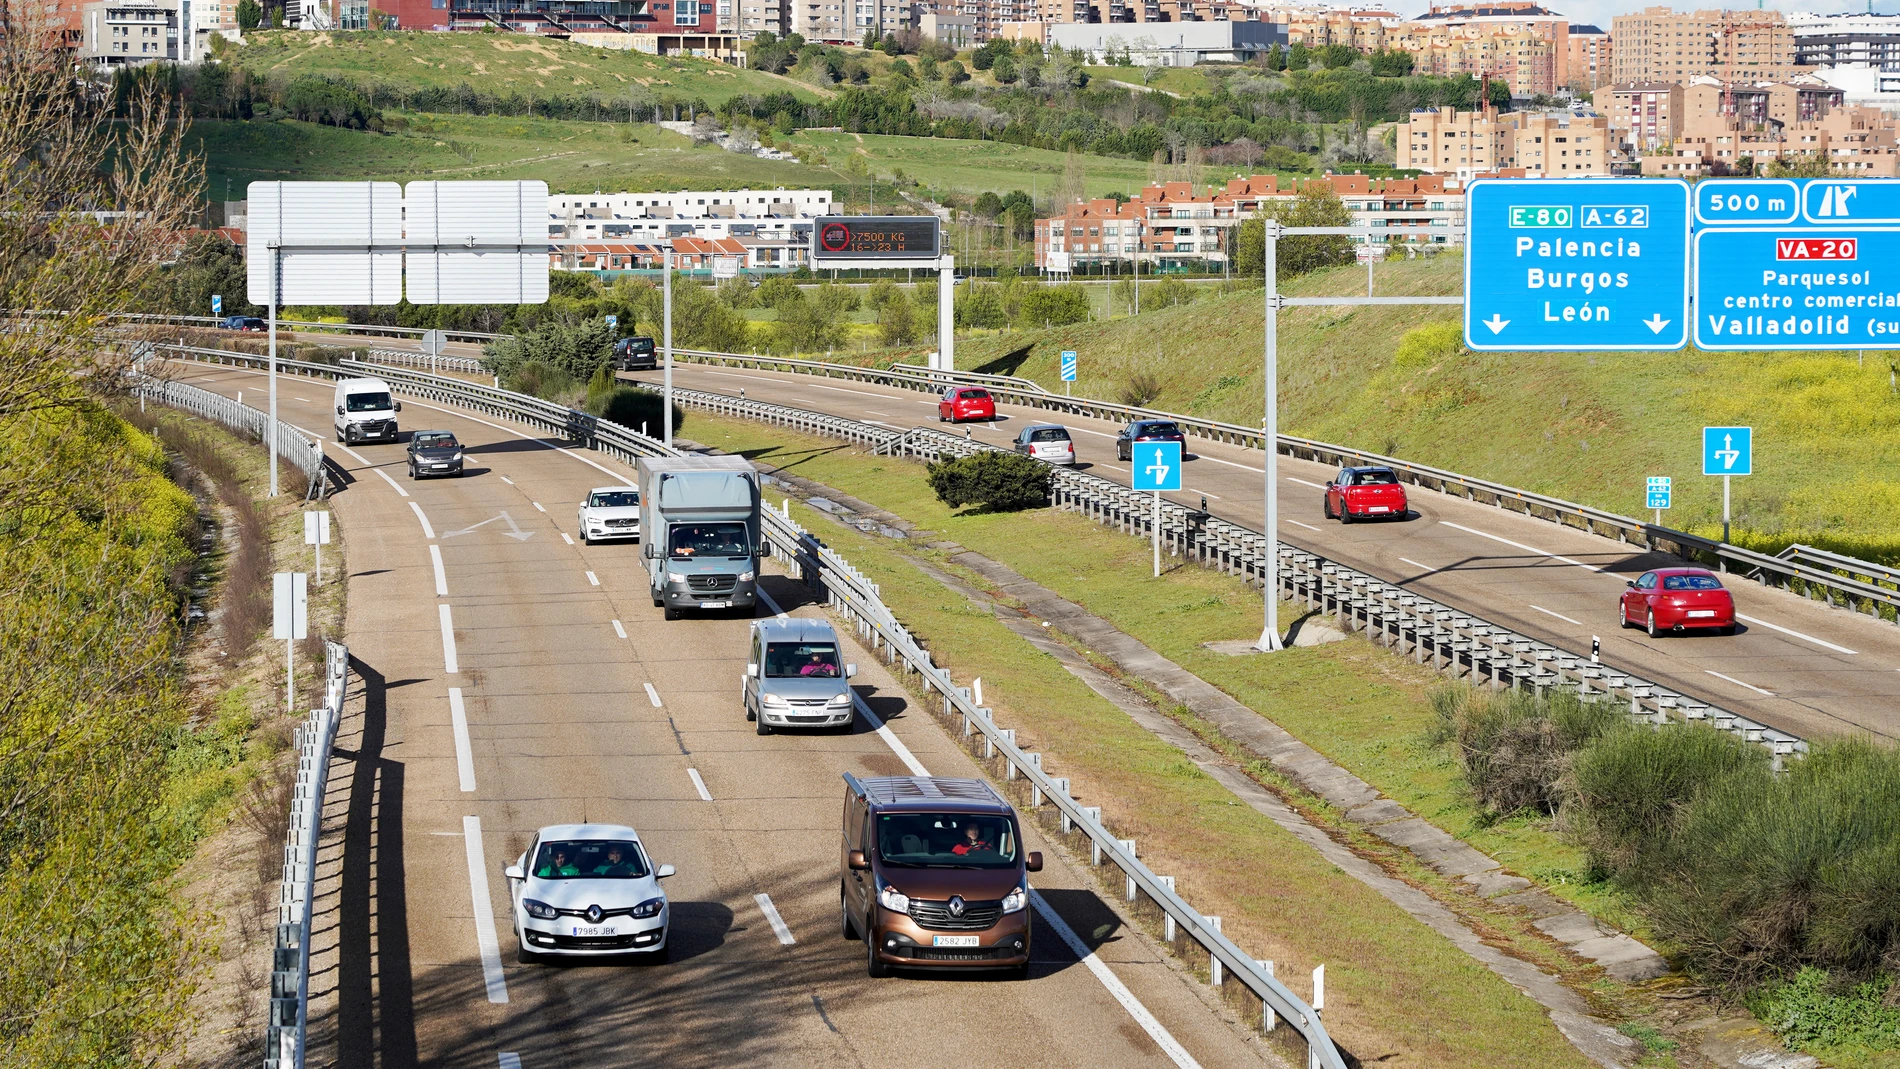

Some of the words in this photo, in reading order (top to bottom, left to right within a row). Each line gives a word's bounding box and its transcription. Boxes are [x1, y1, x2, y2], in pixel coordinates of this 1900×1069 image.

[1710, 194, 1760, 212] 500
[1769, 198, 1786, 212] m
[1512, 208, 1569, 225] E-80
[1585, 208, 1645, 225] A-62
[891, 232, 905, 242] KG
[898, 243, 905, 252] H
[1516, 236, 1641, 257] Palencia
[1779, 240, 1854, 258] VA-20
[1527, 268, 1629, 294] Burgos
[1763, 270, 1870, 290] Parquesol
[1724, 293, 1793, 308] centro
[1804, 292, 1900, 307] comercial
[1544, 301, 1610, 322] León
[1708, 314, 1849, 335] Valladolid
[1867, 318, 1900, 337] (su
[578, 927, 599, 935] 7985
[601, 927, 616, 935] JBK
[939, 937, 960, 945] 2582
[962, 937, 977, 945] JYB
